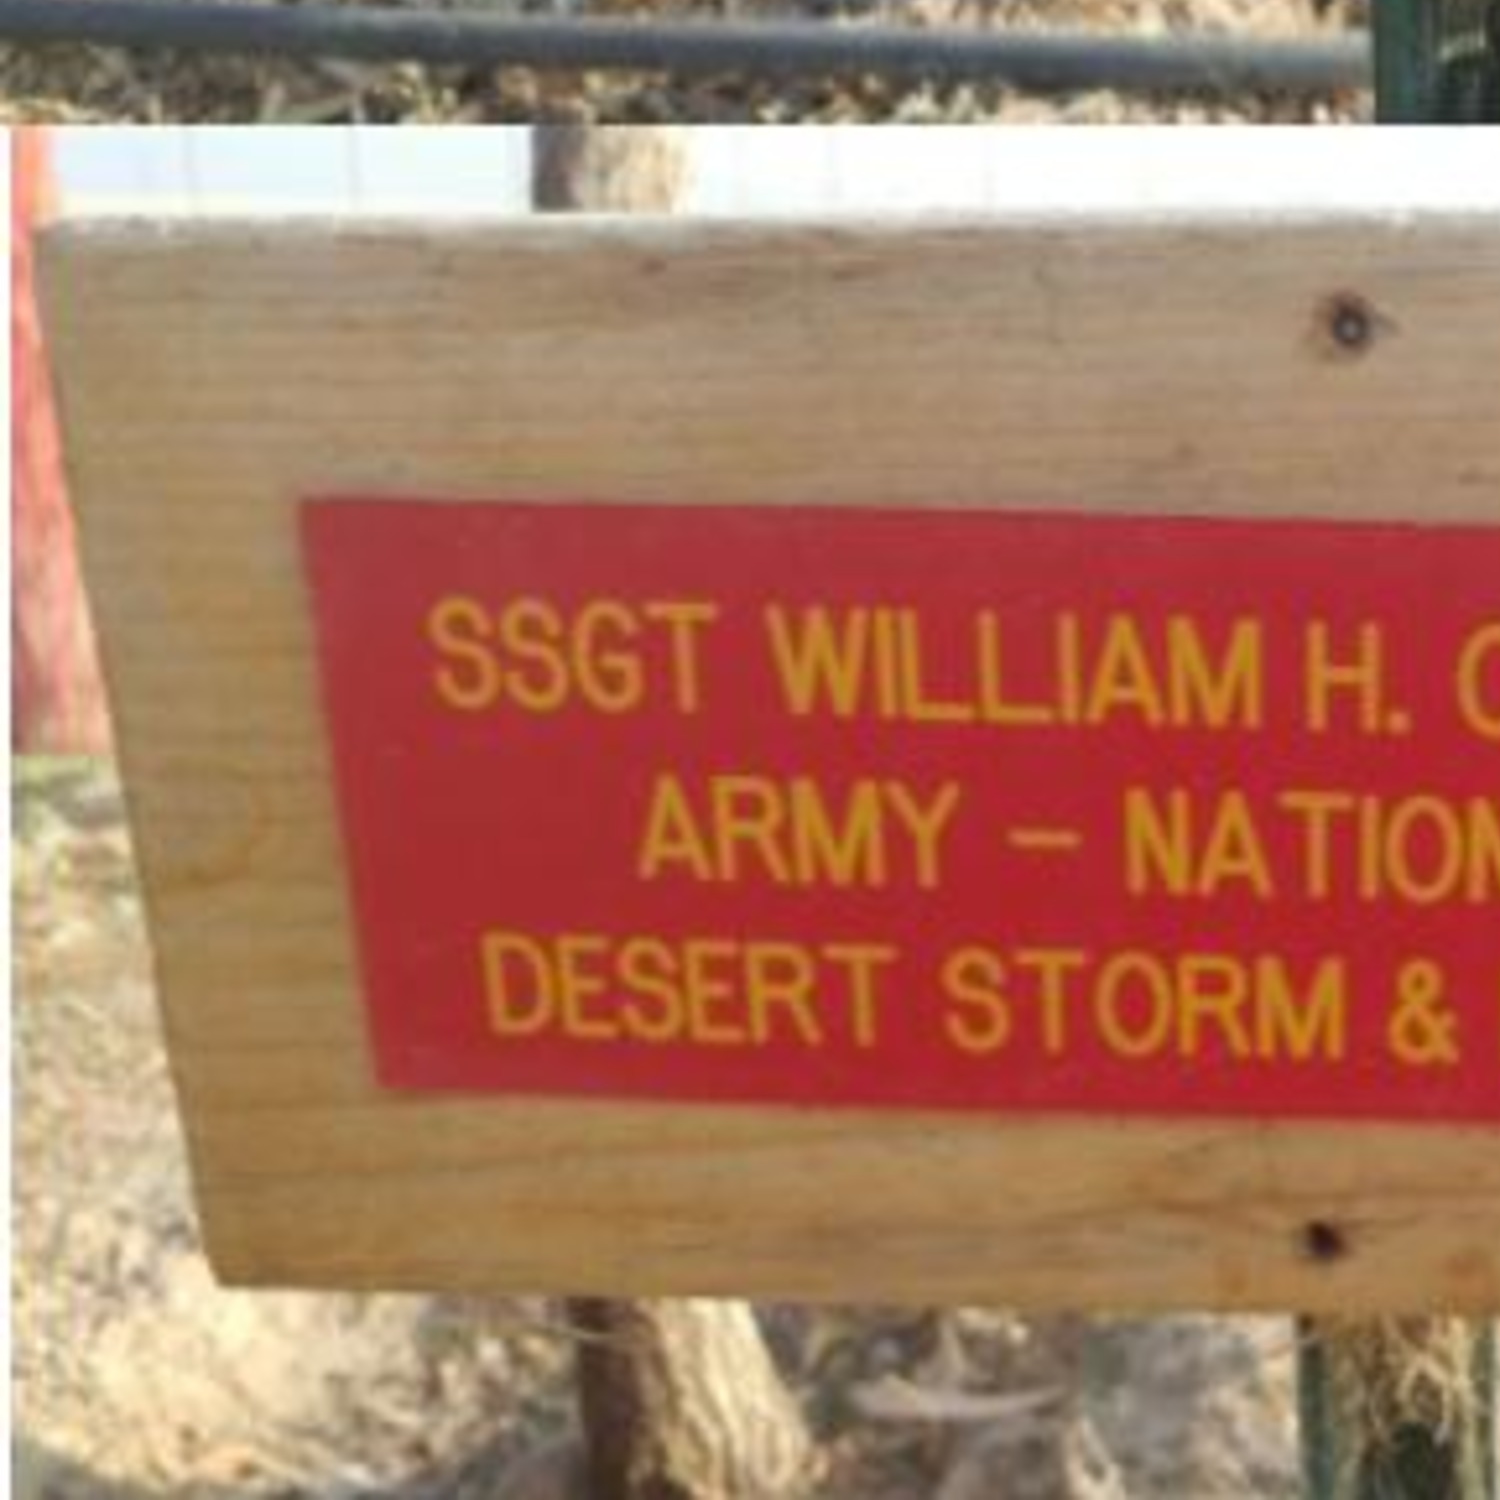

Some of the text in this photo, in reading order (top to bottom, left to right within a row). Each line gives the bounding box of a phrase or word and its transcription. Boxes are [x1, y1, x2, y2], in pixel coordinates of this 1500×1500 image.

[425, 592, 718, 715] SSGT
[764, 604, 1264, 729] WILLIAM
[1304, 620, 1411, 734] H.
[638, 771, 962, 888] ARMY
[480, 929, 894, 1045] DESERT
[942, 945, 1347, 1060] STORM
[1386, 957, 1460, 1066] &
